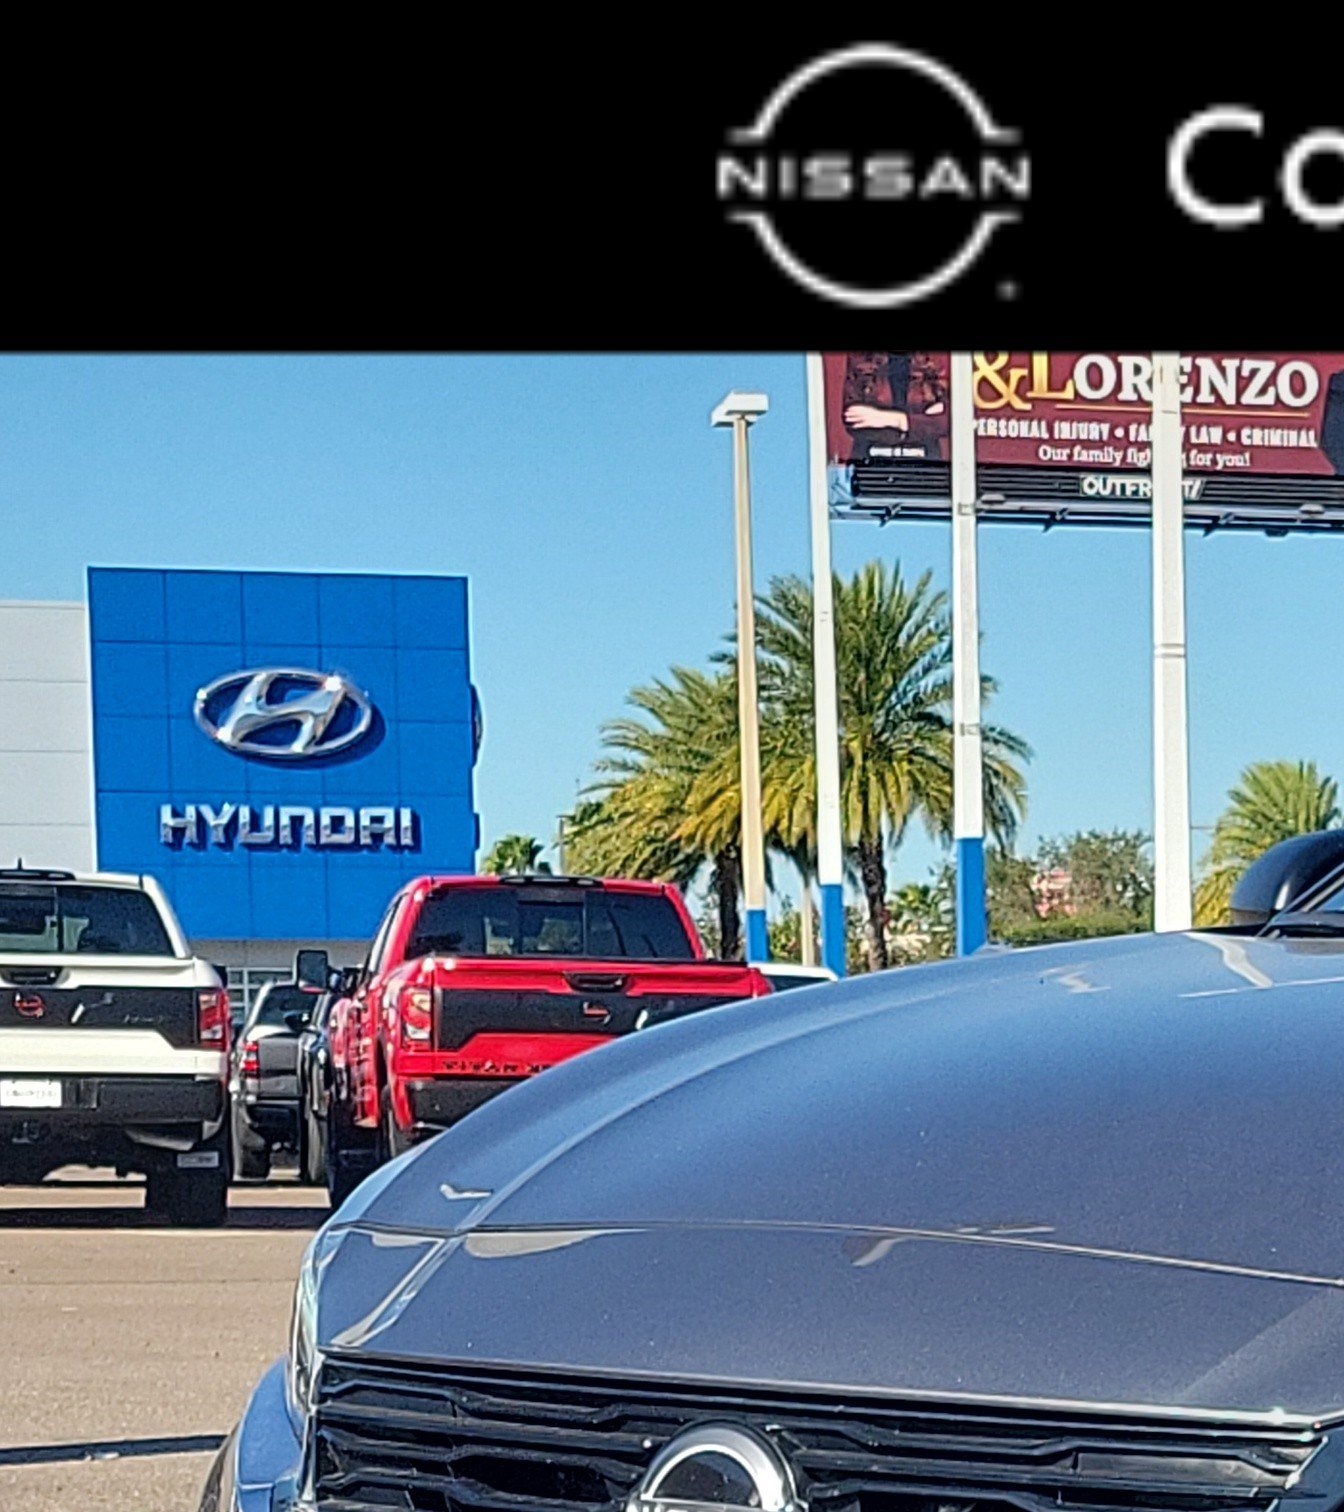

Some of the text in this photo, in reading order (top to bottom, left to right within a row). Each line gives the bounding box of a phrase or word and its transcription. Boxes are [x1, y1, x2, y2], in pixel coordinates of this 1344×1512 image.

[1053, 421, 1110, 440] INJURY
[1189, 425, 1223, 445] LAW
[1241, 426, 1318, 448] CRIMINAL
[1038, 445, 1070, 461] Our
[1073, 445, 1123, 467] family
[1189, 449, 1213, 466] for
[1082, 475, 1201, 499] OUTFRT/
[160, 802, 415, 846] HYUNDAI
